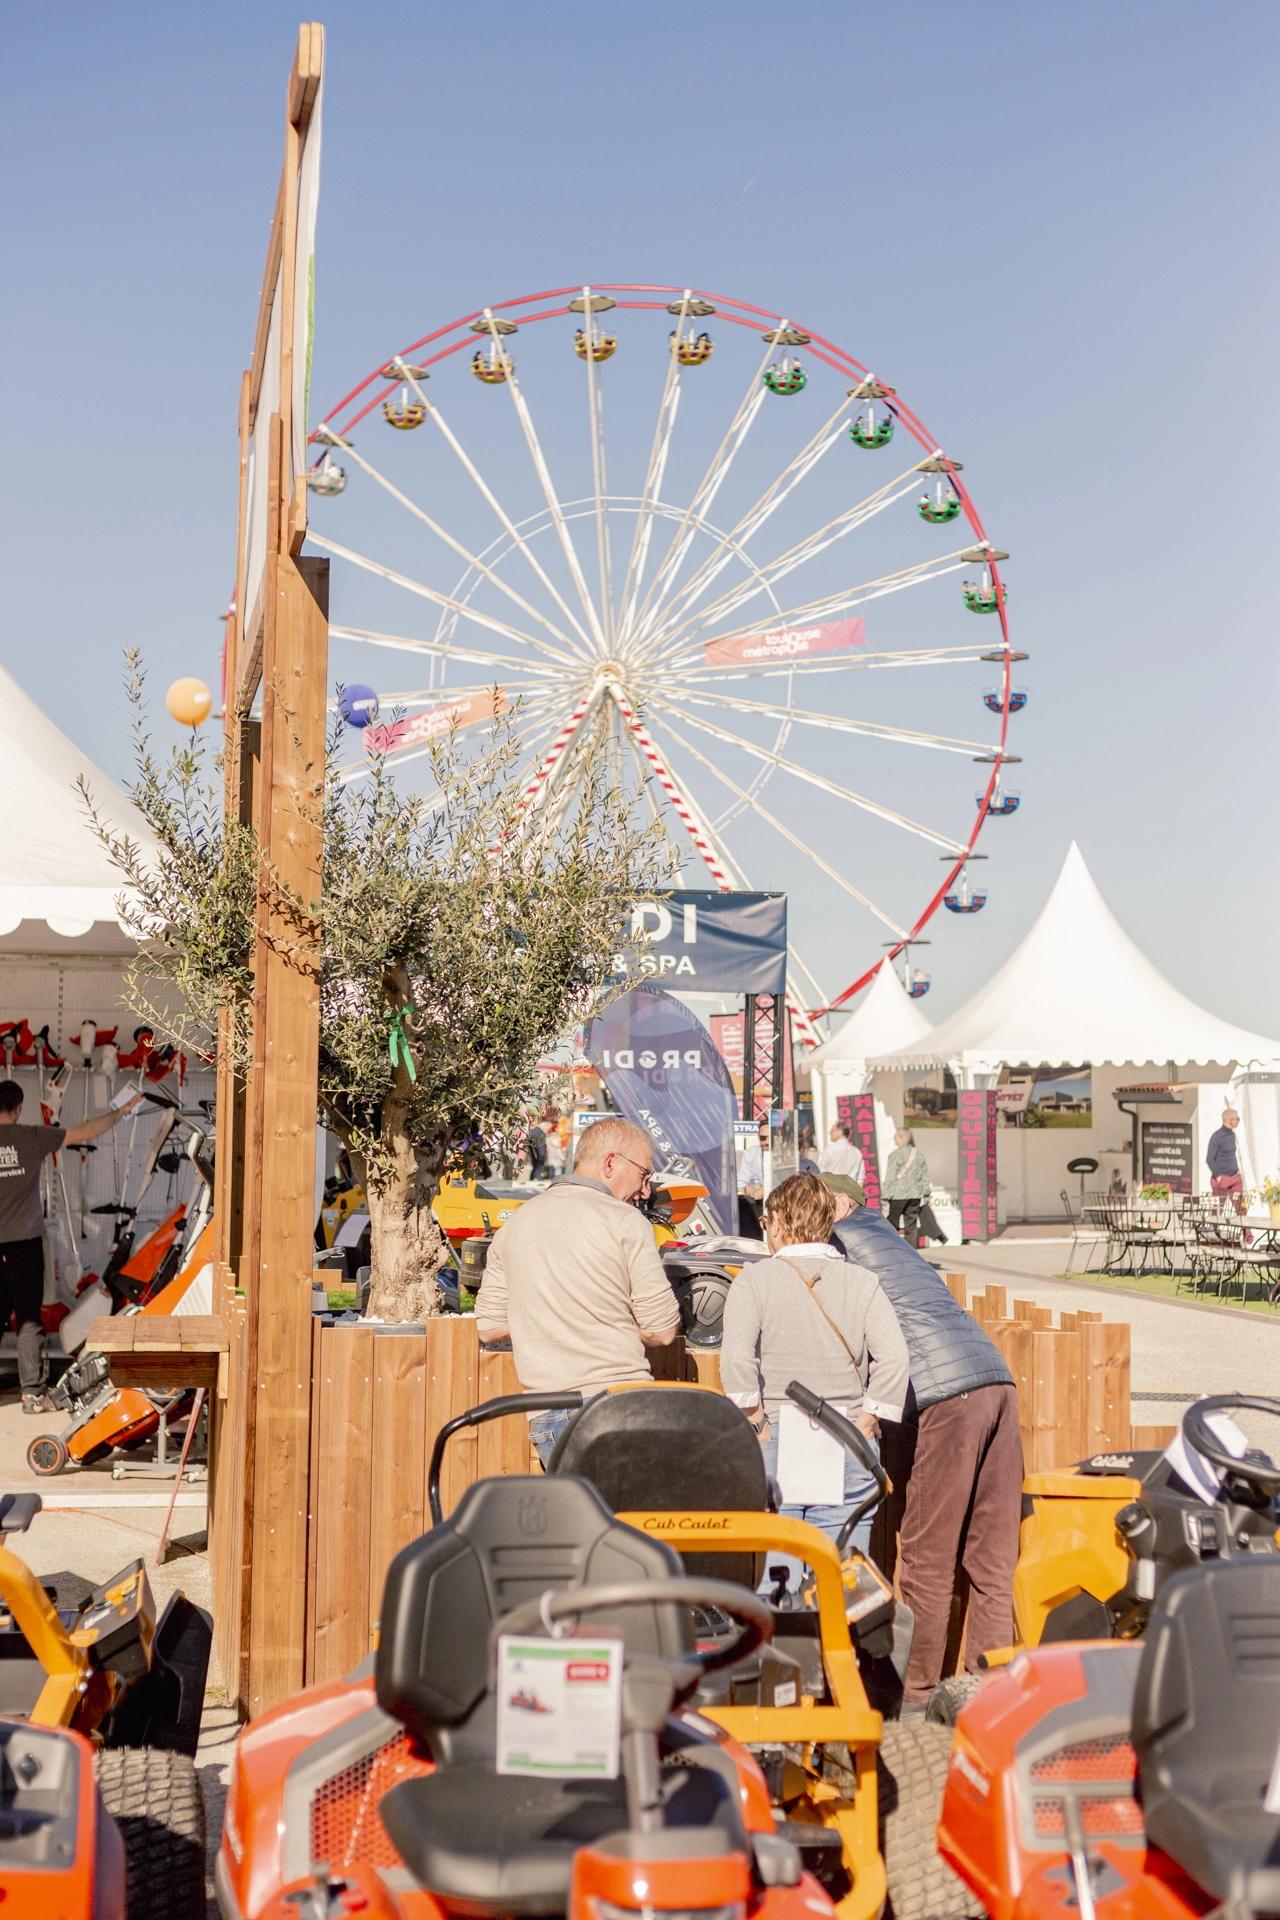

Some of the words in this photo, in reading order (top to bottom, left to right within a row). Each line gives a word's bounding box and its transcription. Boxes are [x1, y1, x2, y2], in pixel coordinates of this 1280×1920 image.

[765, 629, 821, 646] toulouse
[631, 902, 697, 944] DI
[640, 954, 697, 975] SPA
[733, 1124, 760, 1132] STRA
[0, 1145, 18, 1155] RAL
[853, 1095, 881, 1209] HABILLAGE
[0, 1155, 19, 1164] TER
[987, 1091, 997, 1235] COUVERTINES
[643, 1517, 676, 1529] Cub
[678, 1517, 732, 1529] Cadet
